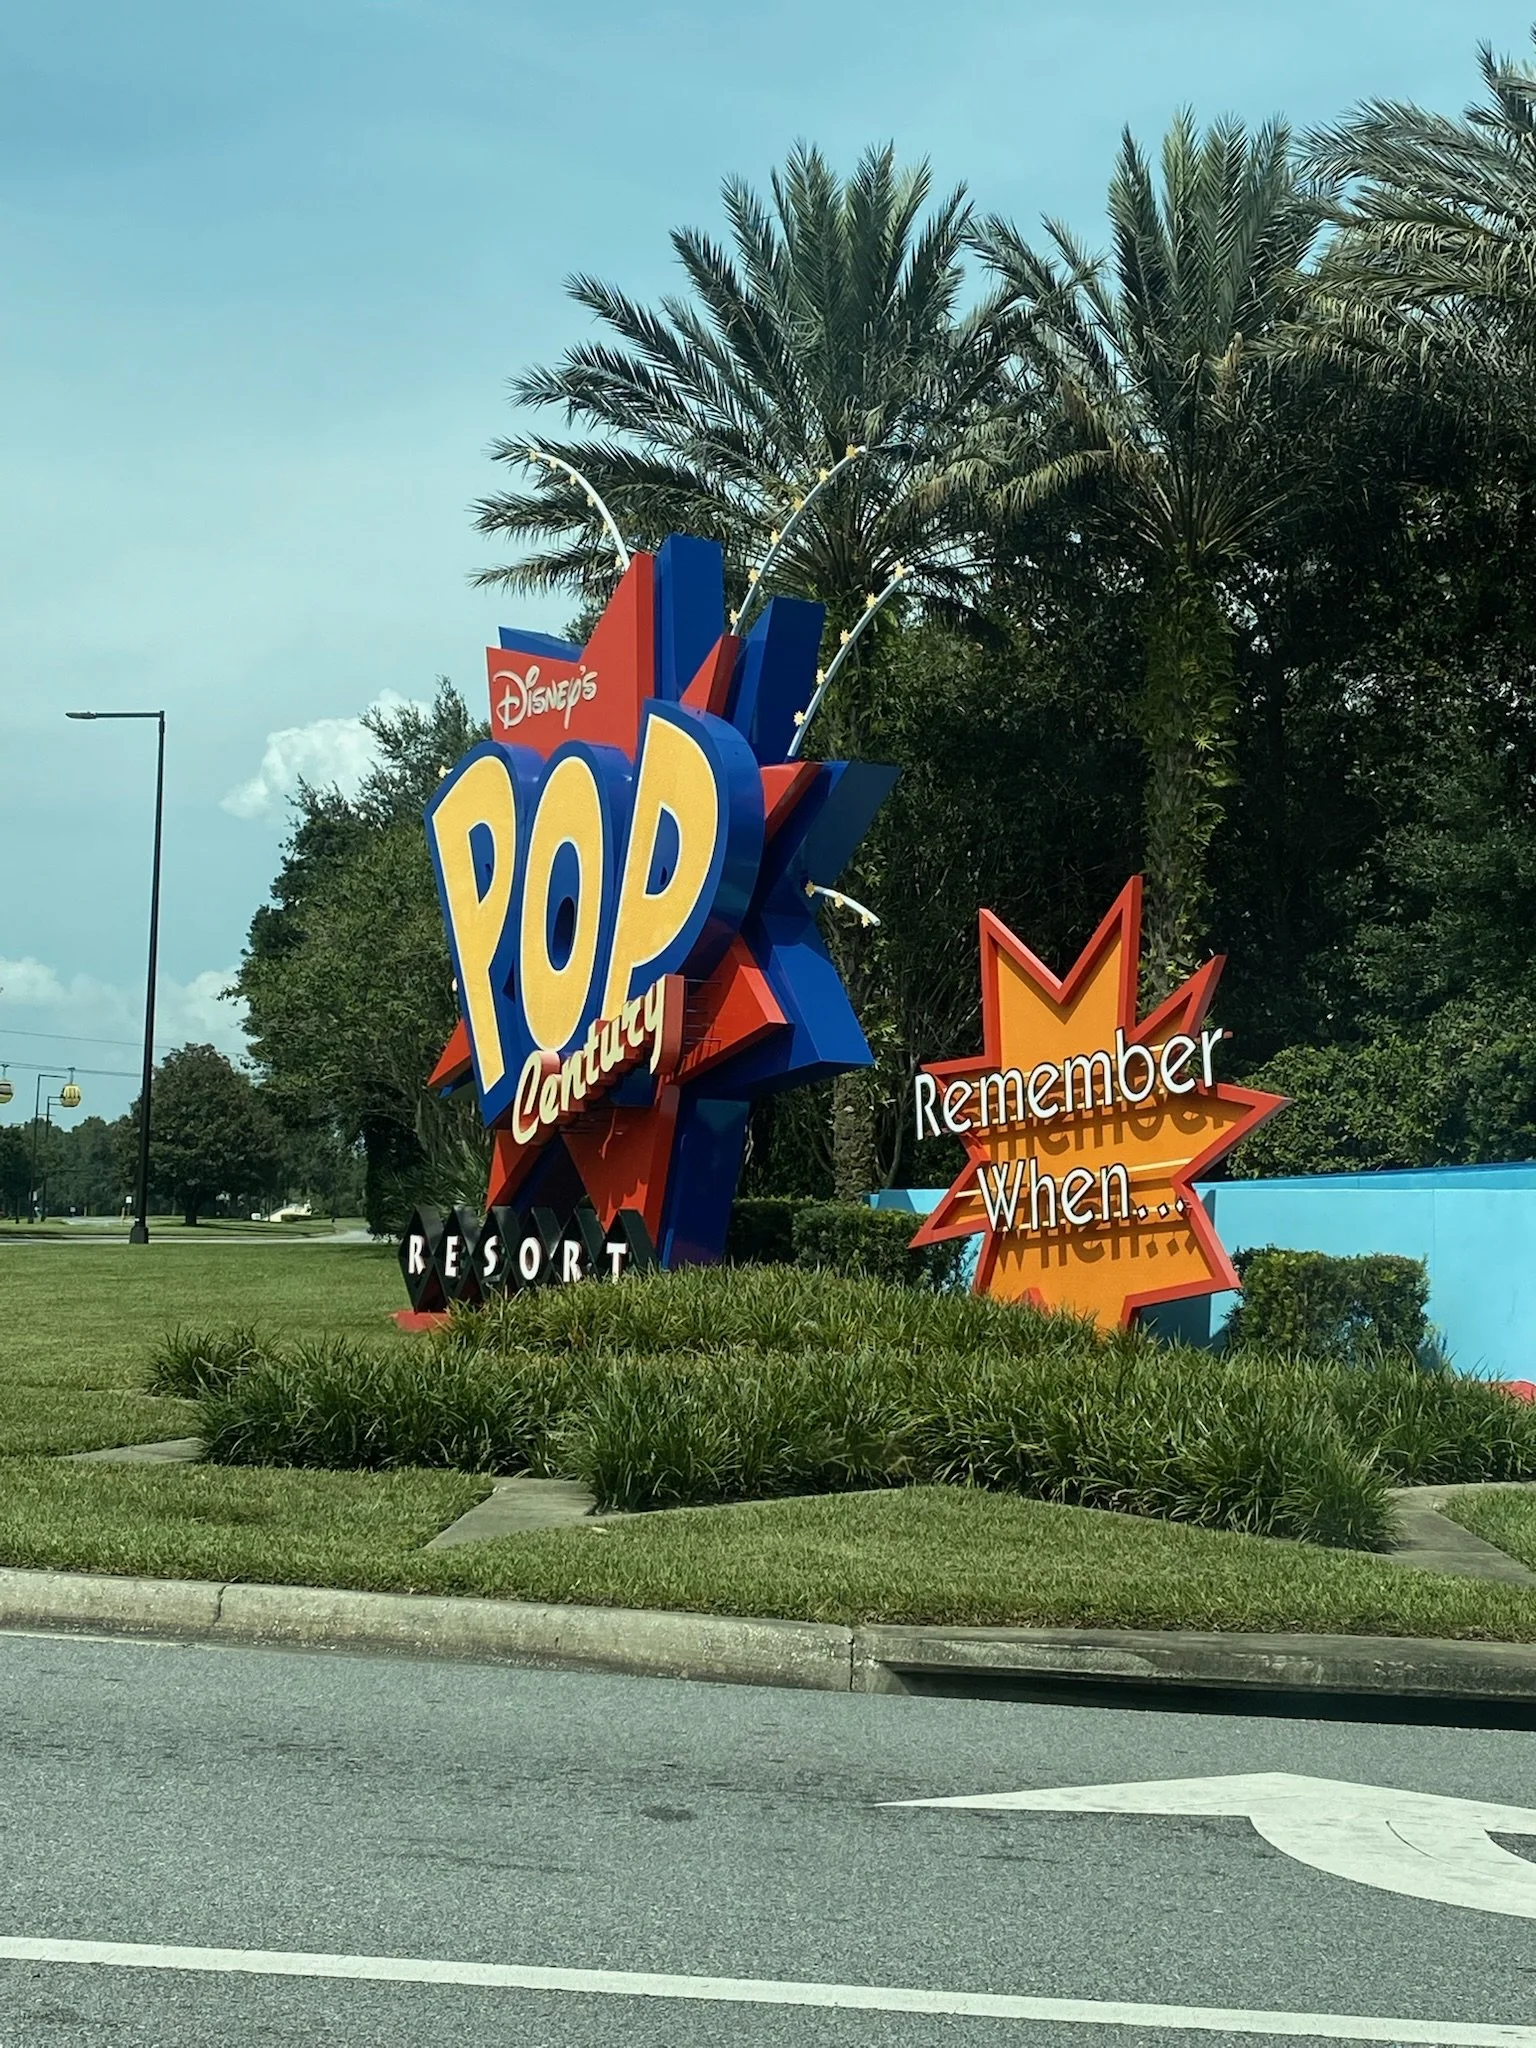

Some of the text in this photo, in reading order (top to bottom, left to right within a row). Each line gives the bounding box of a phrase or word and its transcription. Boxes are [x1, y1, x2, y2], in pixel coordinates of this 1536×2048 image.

[432, 713, 718, 1095] POP
[512, 974, 666, 1145] Century
[915, 1027, 1225, 1141] Remember
[977, 1158, 1185, 1232] When...
[408, 1235, 628, 1284] RESORT
